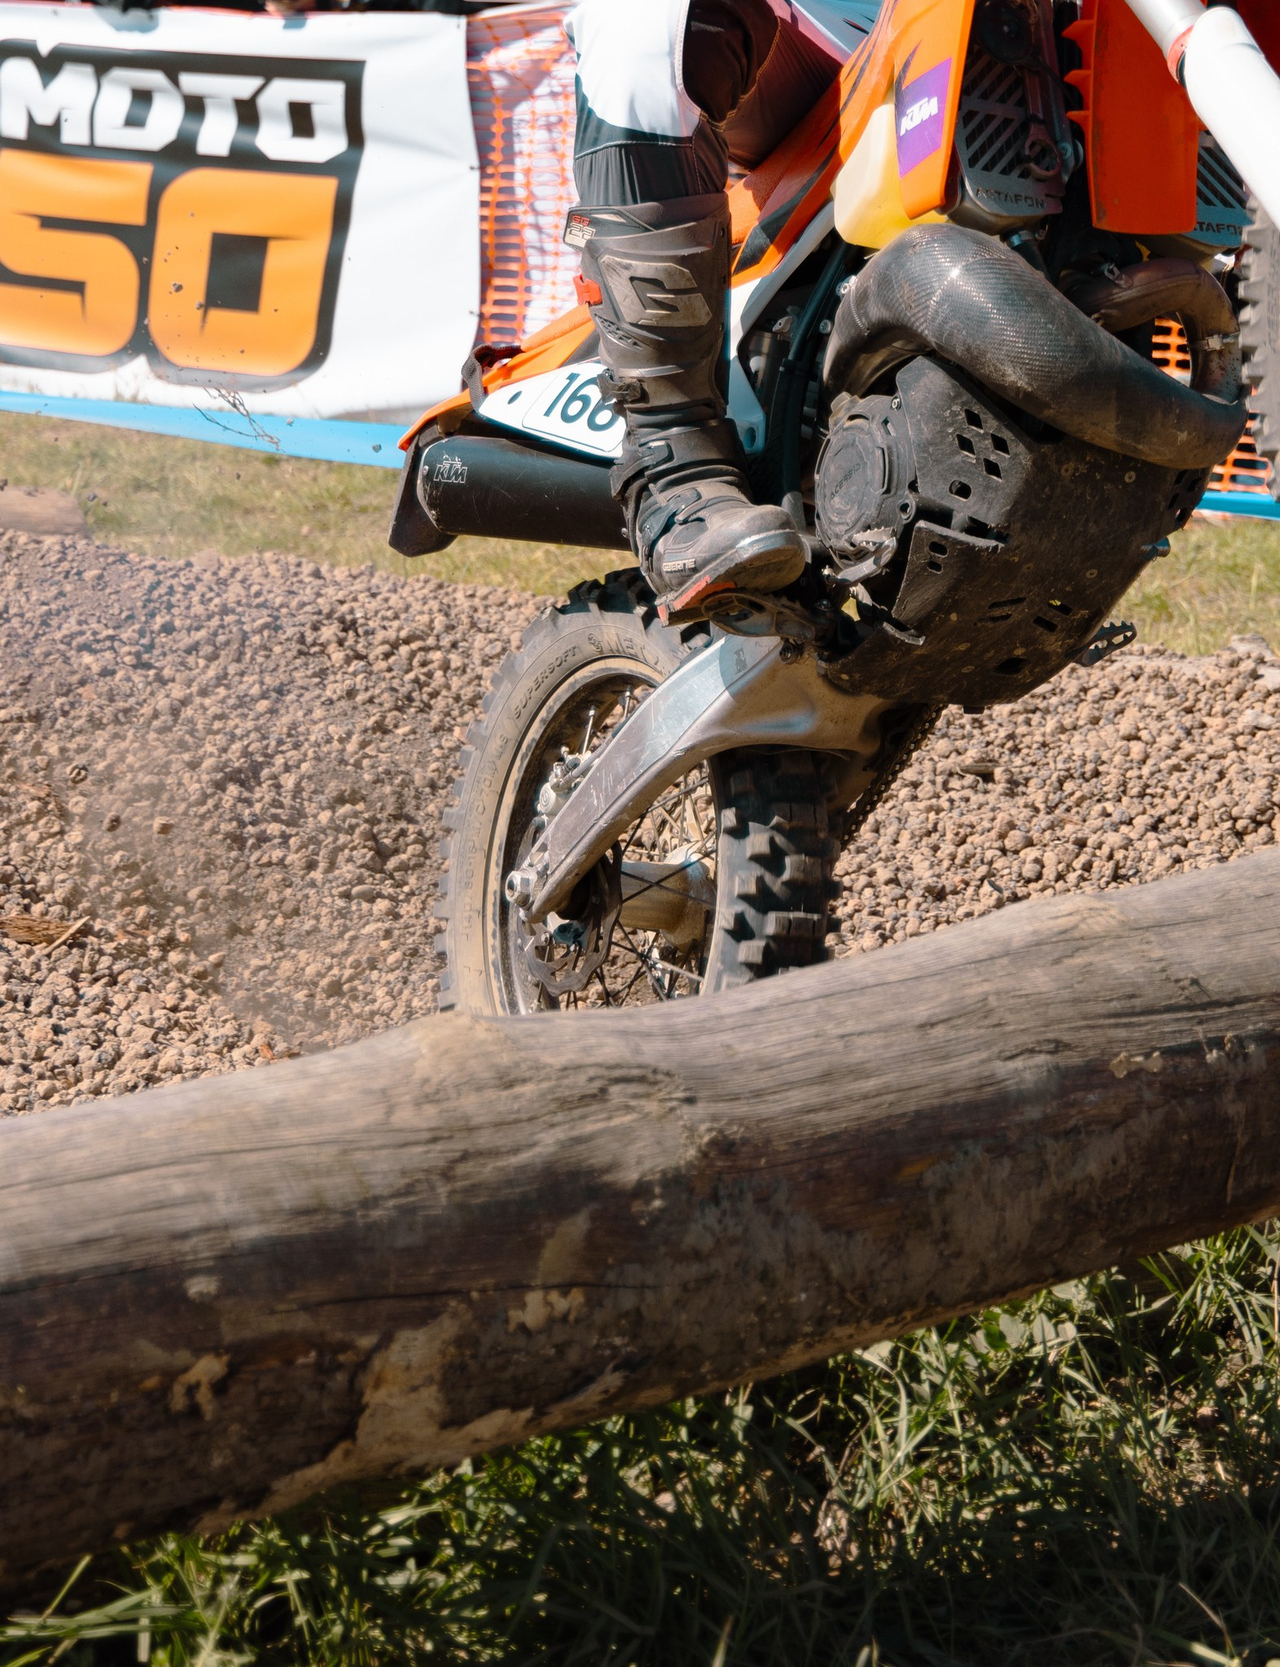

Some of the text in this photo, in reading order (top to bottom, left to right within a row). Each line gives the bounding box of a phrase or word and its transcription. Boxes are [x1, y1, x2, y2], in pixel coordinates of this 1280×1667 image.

[900, 95, 938, 136] KTM
[572, 215, 590, 226] SG
[543, 372, 620, 432] 166
[434, 465, 467, 483] KTM
